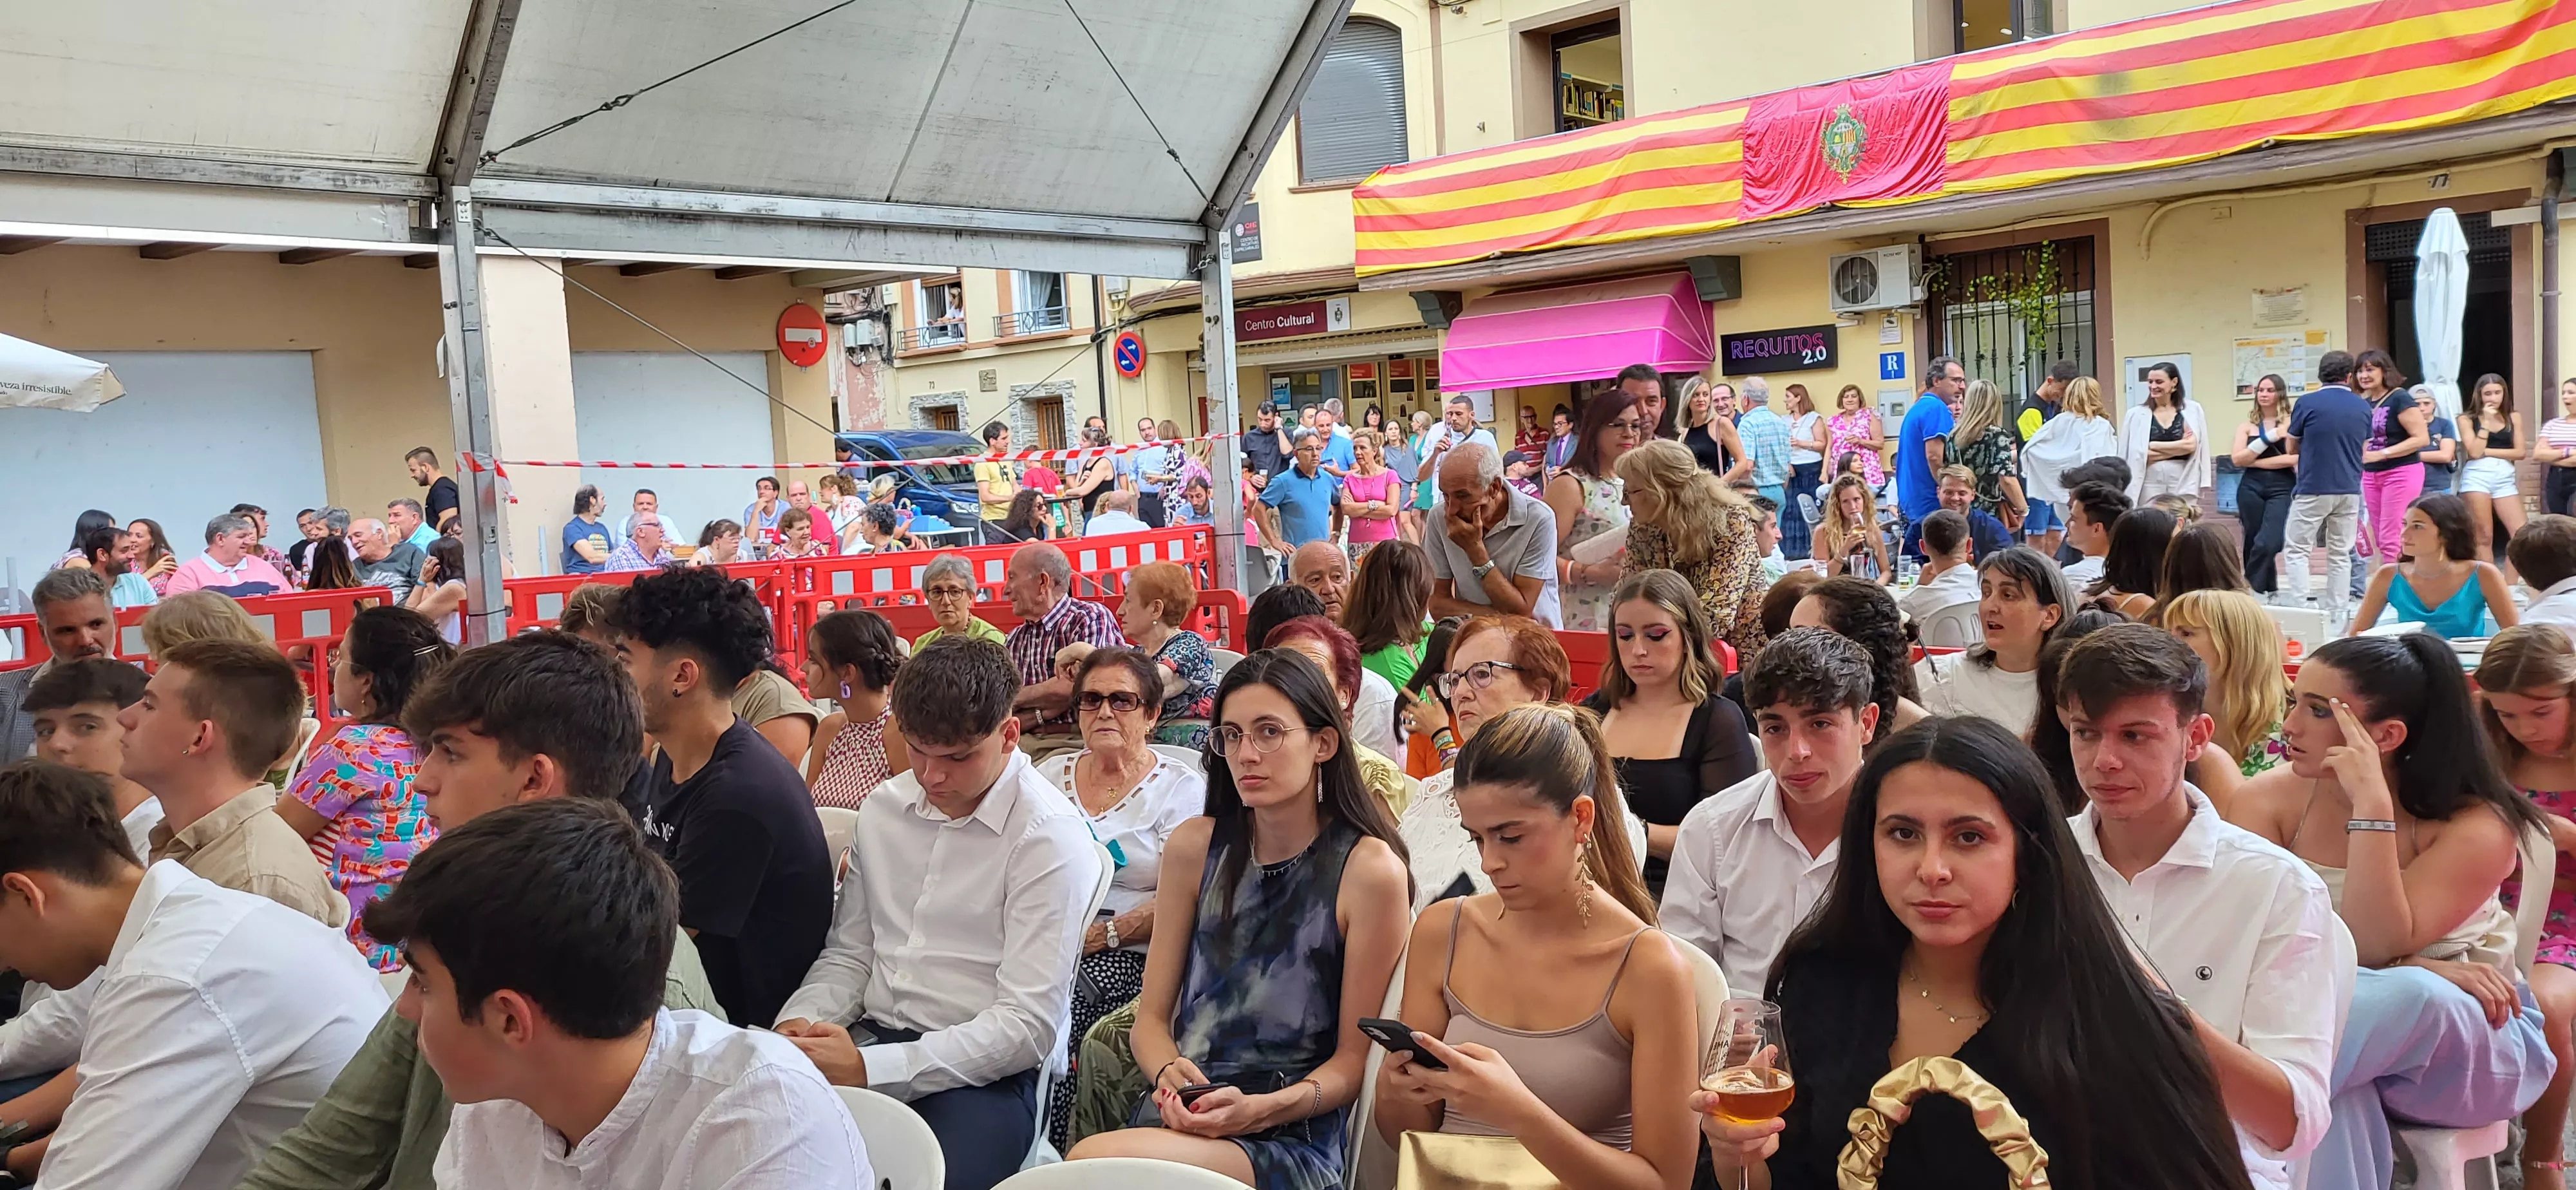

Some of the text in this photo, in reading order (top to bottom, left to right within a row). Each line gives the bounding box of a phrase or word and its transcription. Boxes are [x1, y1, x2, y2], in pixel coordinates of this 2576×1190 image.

[1245, 312, 1314, 332] Centro Cultural
[1802, 346, 1827, 364] 2.0
[1886, 355, 1899, 370] R
